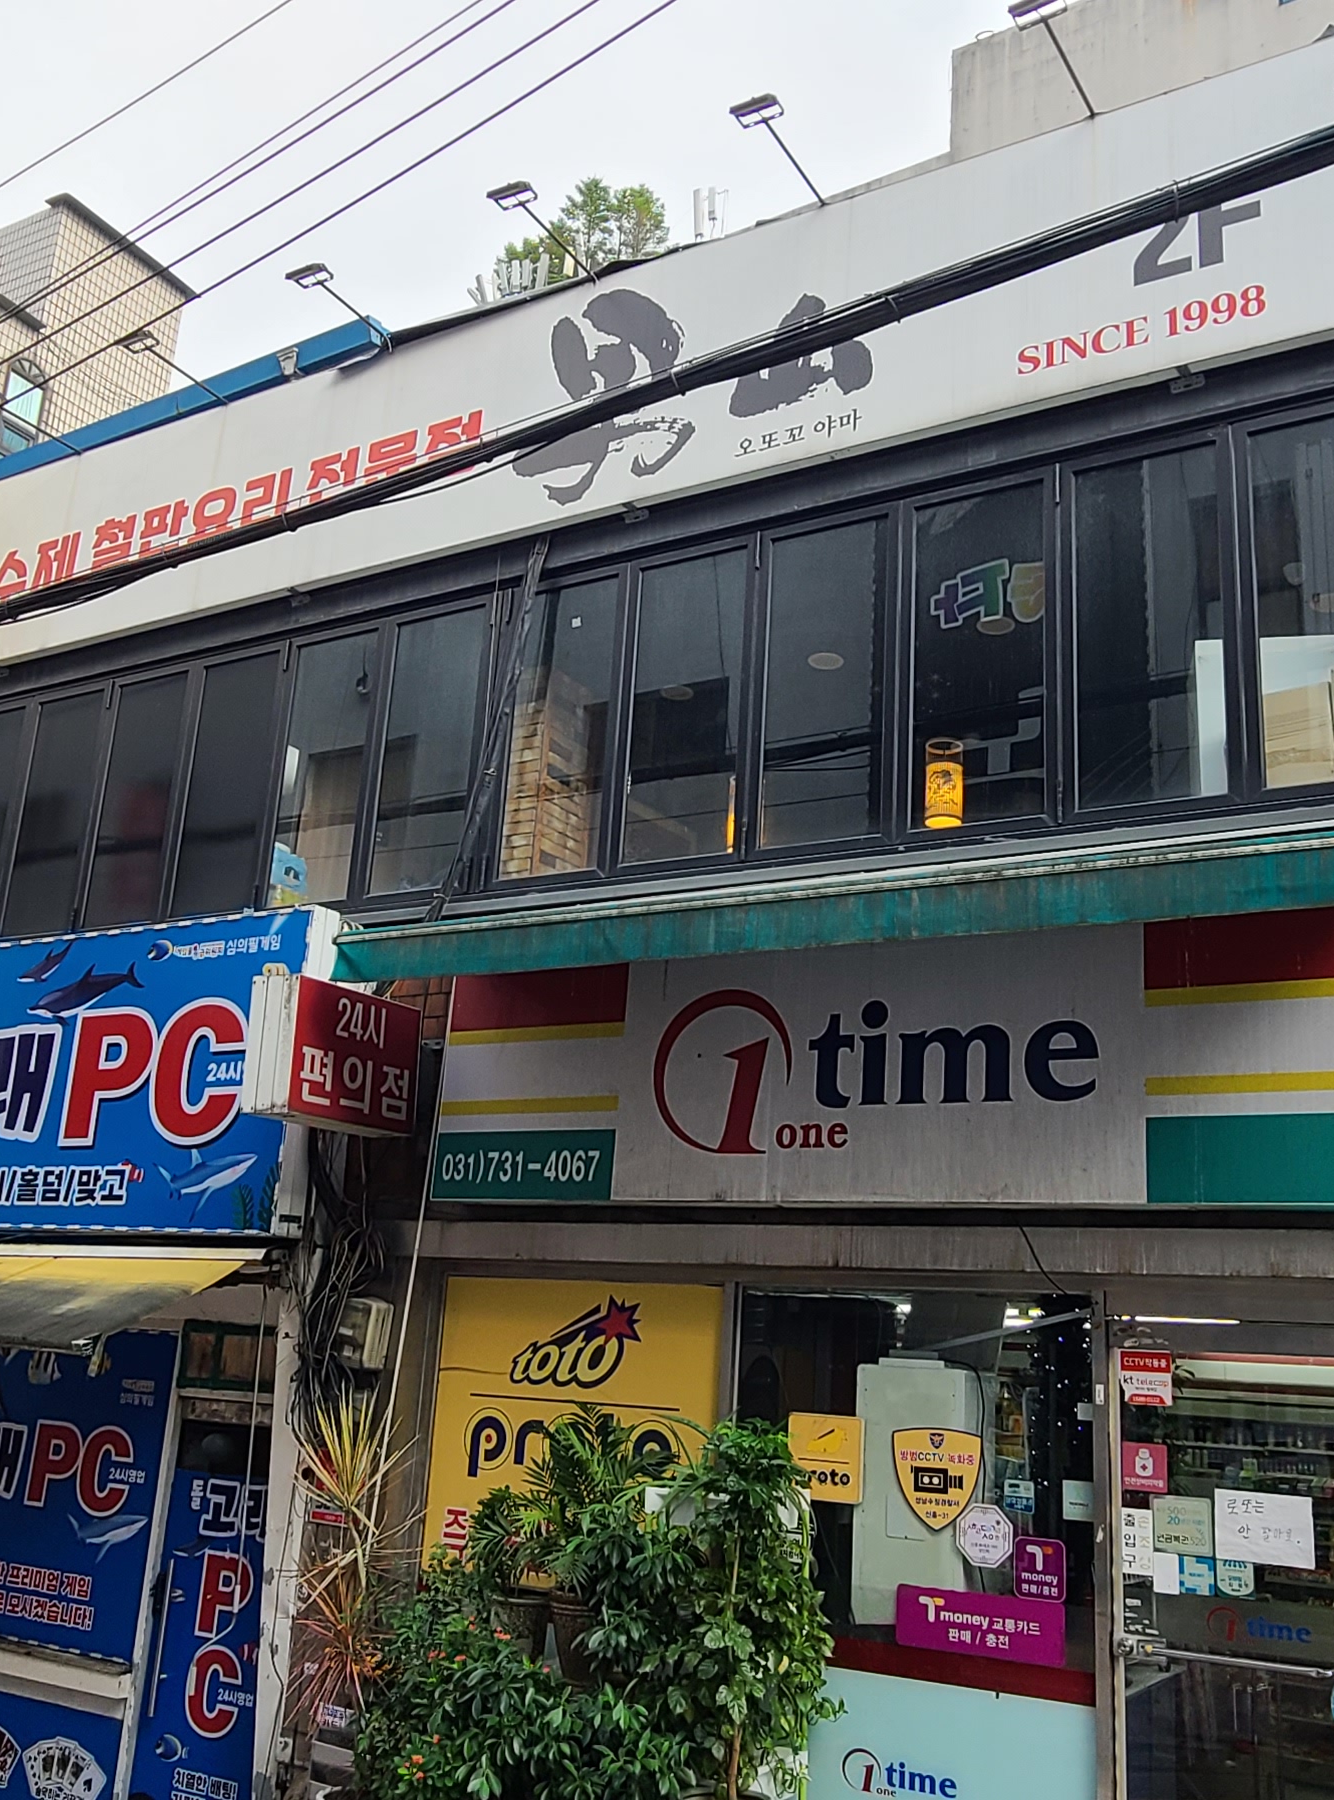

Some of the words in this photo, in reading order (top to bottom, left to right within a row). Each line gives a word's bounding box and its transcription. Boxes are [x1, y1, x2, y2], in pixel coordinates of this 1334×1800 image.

[1016, 315, 1150, 376] SINCE
[1163, 284, 1266, 338] 1998
[733, 424, 806, 458] 오또꼬
[813, 409, 863, 438] 야마
[335, 996, 387, 1050] 24시
[807, 998, 1100, 1107] time
[57, 995, 249, 1149] PC
[205, 1060, 247, 1083] 24시
[299, 1045, 410, 1121] 편의점
[774, 1120, 849, 1150] one
[441, 1148, 601, 1184] 031)731-4067
[510, 1334, 625, 1389] toto
[1123, 1374, 1134, 1386] kt
[23, 1418, 134, 1519] PC
[1226, 1498, 1266, 1516] 로또는
[1236, 1523, 1252, 1540] 안
[60, 1572, 93, 1601] 게임
[1020, 1572, 1059, 1586] money
[947, 1628, 973, 1645] 판매
[984, 1632, 1011, 1650] 충전
[991, 1616, 1042, 1636] 교통카드
[875, 1785, 898, 1799] one
[884, 1760, 958, 1800] time
